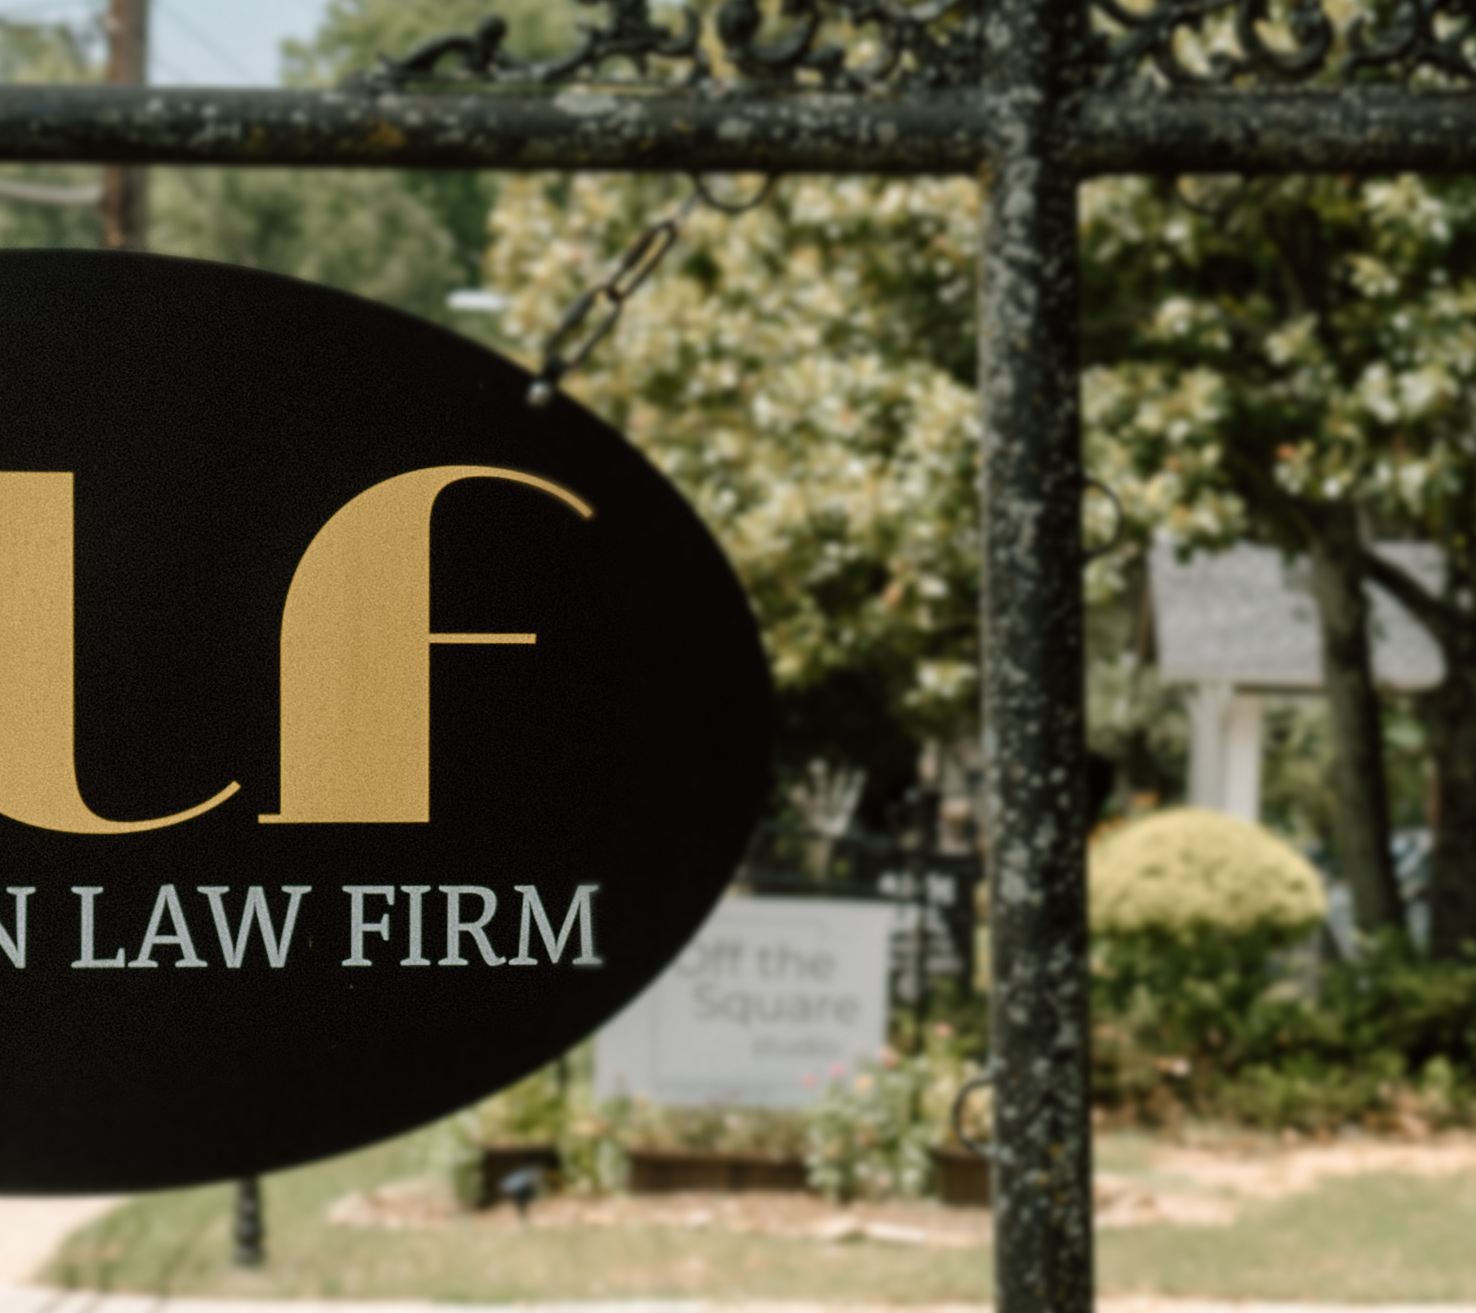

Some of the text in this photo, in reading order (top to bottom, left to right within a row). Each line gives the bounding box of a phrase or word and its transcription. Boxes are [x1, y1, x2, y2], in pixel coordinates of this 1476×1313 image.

[70, 883, 313, 970] LAW
[341, 884, 603, 968] FIRM
[757, 941, 836, 982] the
[692, 982, 860, 1028] Square
